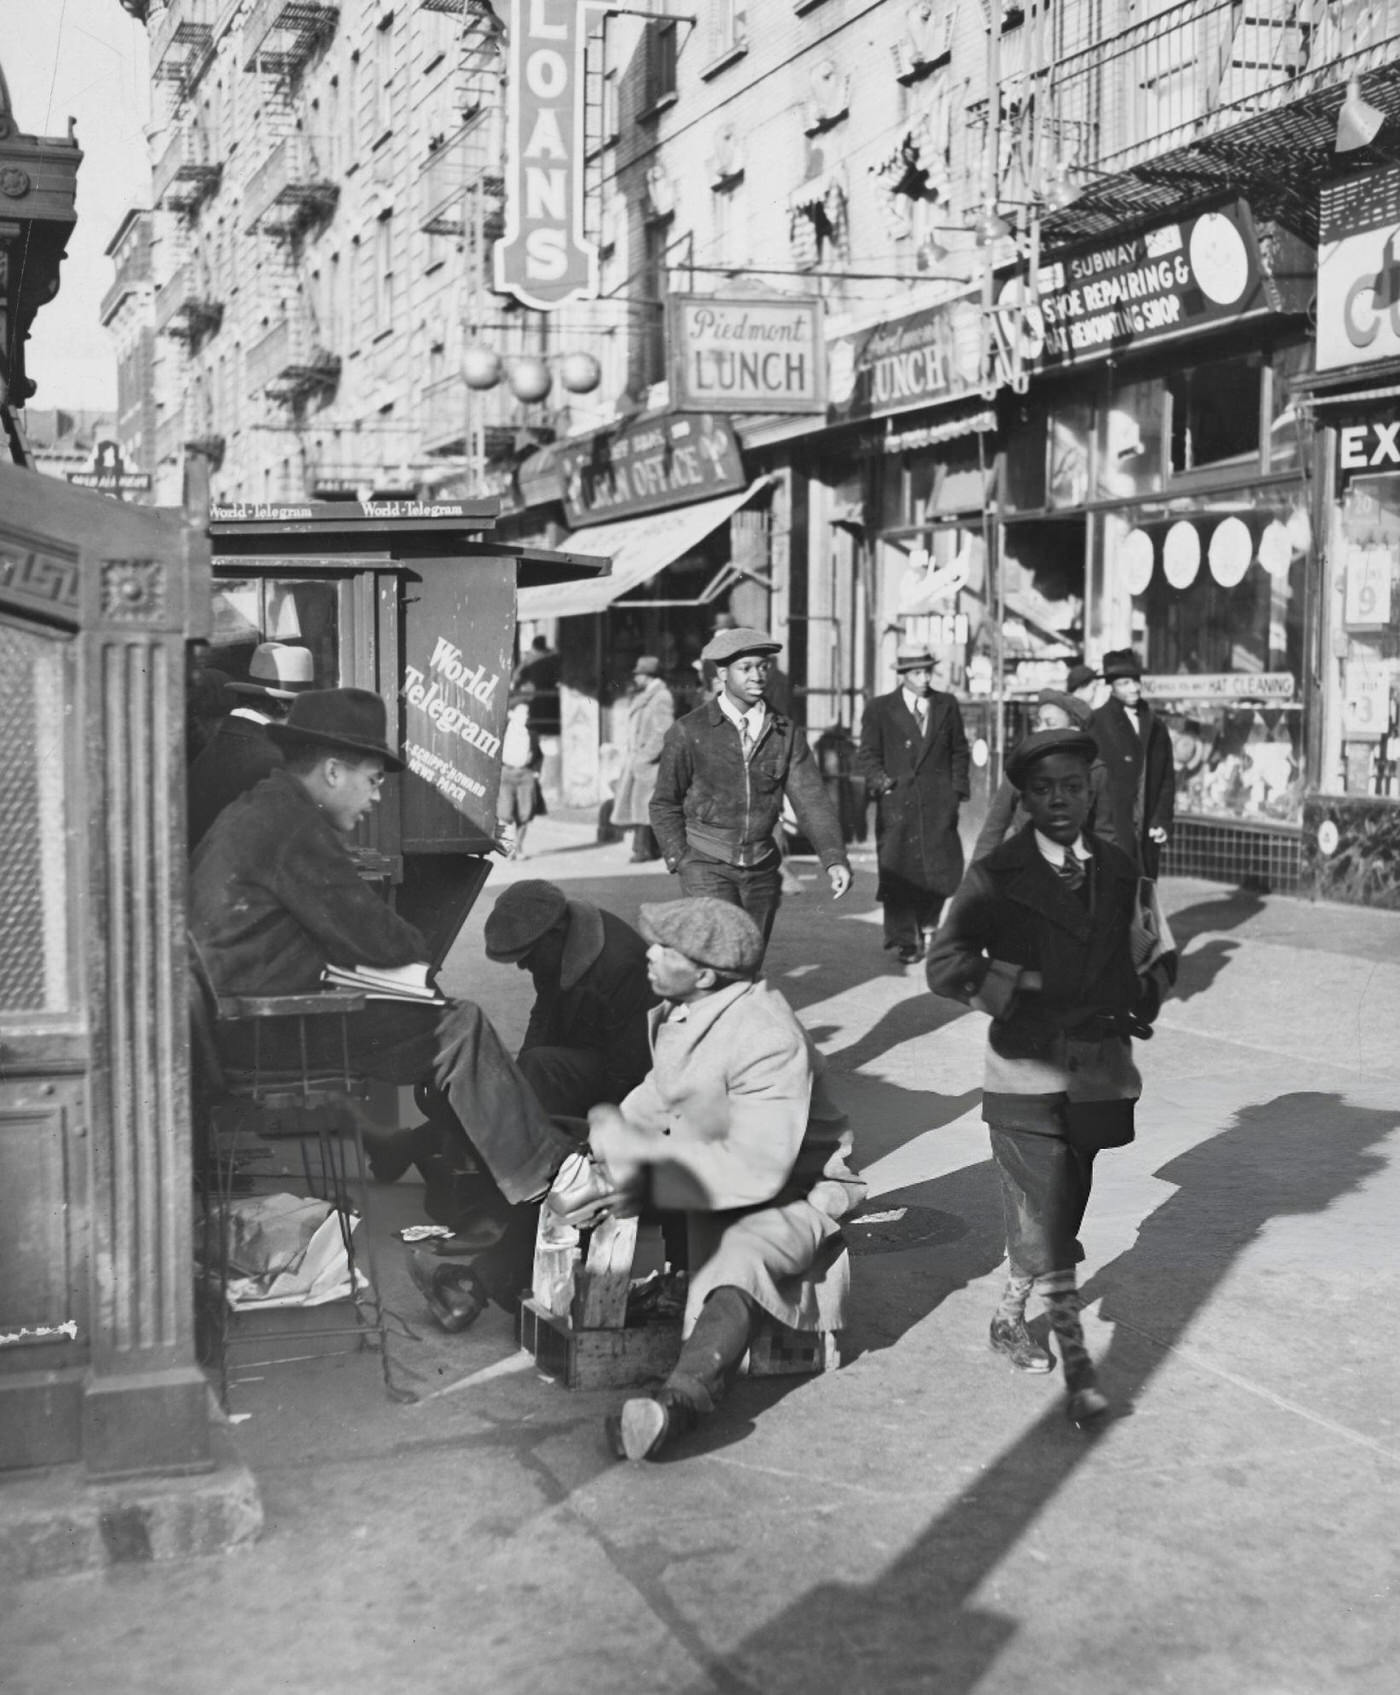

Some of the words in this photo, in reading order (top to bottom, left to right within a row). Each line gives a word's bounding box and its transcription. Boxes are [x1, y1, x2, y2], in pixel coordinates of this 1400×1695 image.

[523, 0, 568, 280] LOANS
[1071, 241, 1138, 279] SUBWAY
[1083, 261, 1174, 312] REPAIRING
[1174, 255, 1190, 285] &
[689, 308, 806, 342] Piedmont
[1143, 294, 1181, 329] SHOP
[695, 350, 804, 391] LUNCH
[209, 502, 313, 520] World-Telegram
[360, 500, 463, 518] World-Telegram
[430, 636, 499, 705] World
[1233, 677, 1292, 694] CLEANING
[403, 665, 501, 758] Telegram
